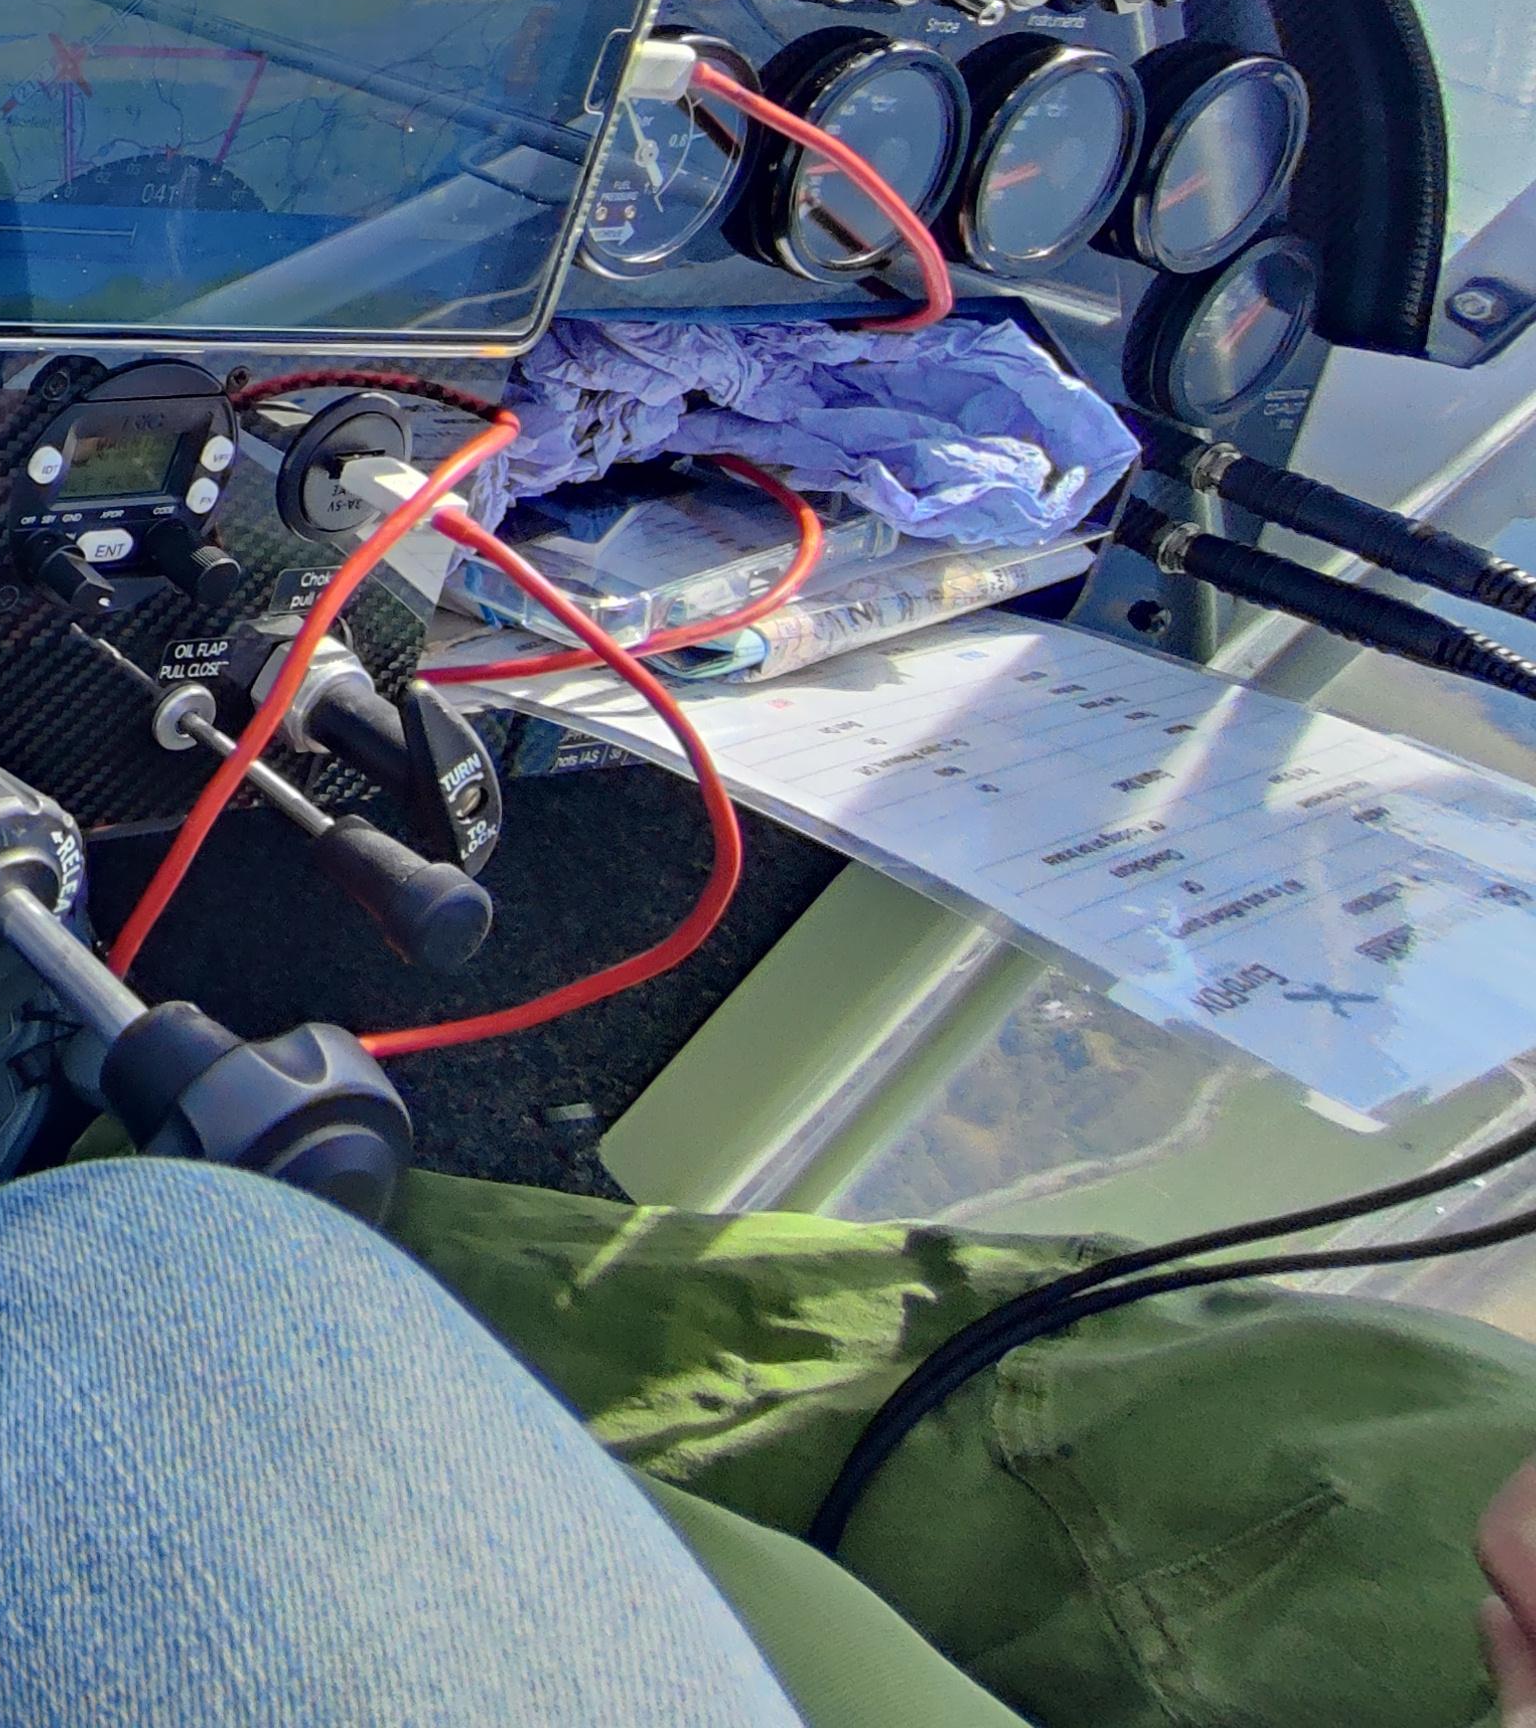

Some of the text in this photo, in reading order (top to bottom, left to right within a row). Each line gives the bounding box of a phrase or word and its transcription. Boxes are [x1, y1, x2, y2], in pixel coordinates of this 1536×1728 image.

[95, 544, 125, 558] ENT
[175, 641, 228, 659] OIL FLAP
[159, 664, 184, 680] PULL
[440, 753, 481, 792] TURN
[467, 820, 486, 839] TO
[461, 824, 496, 860] LOCK
